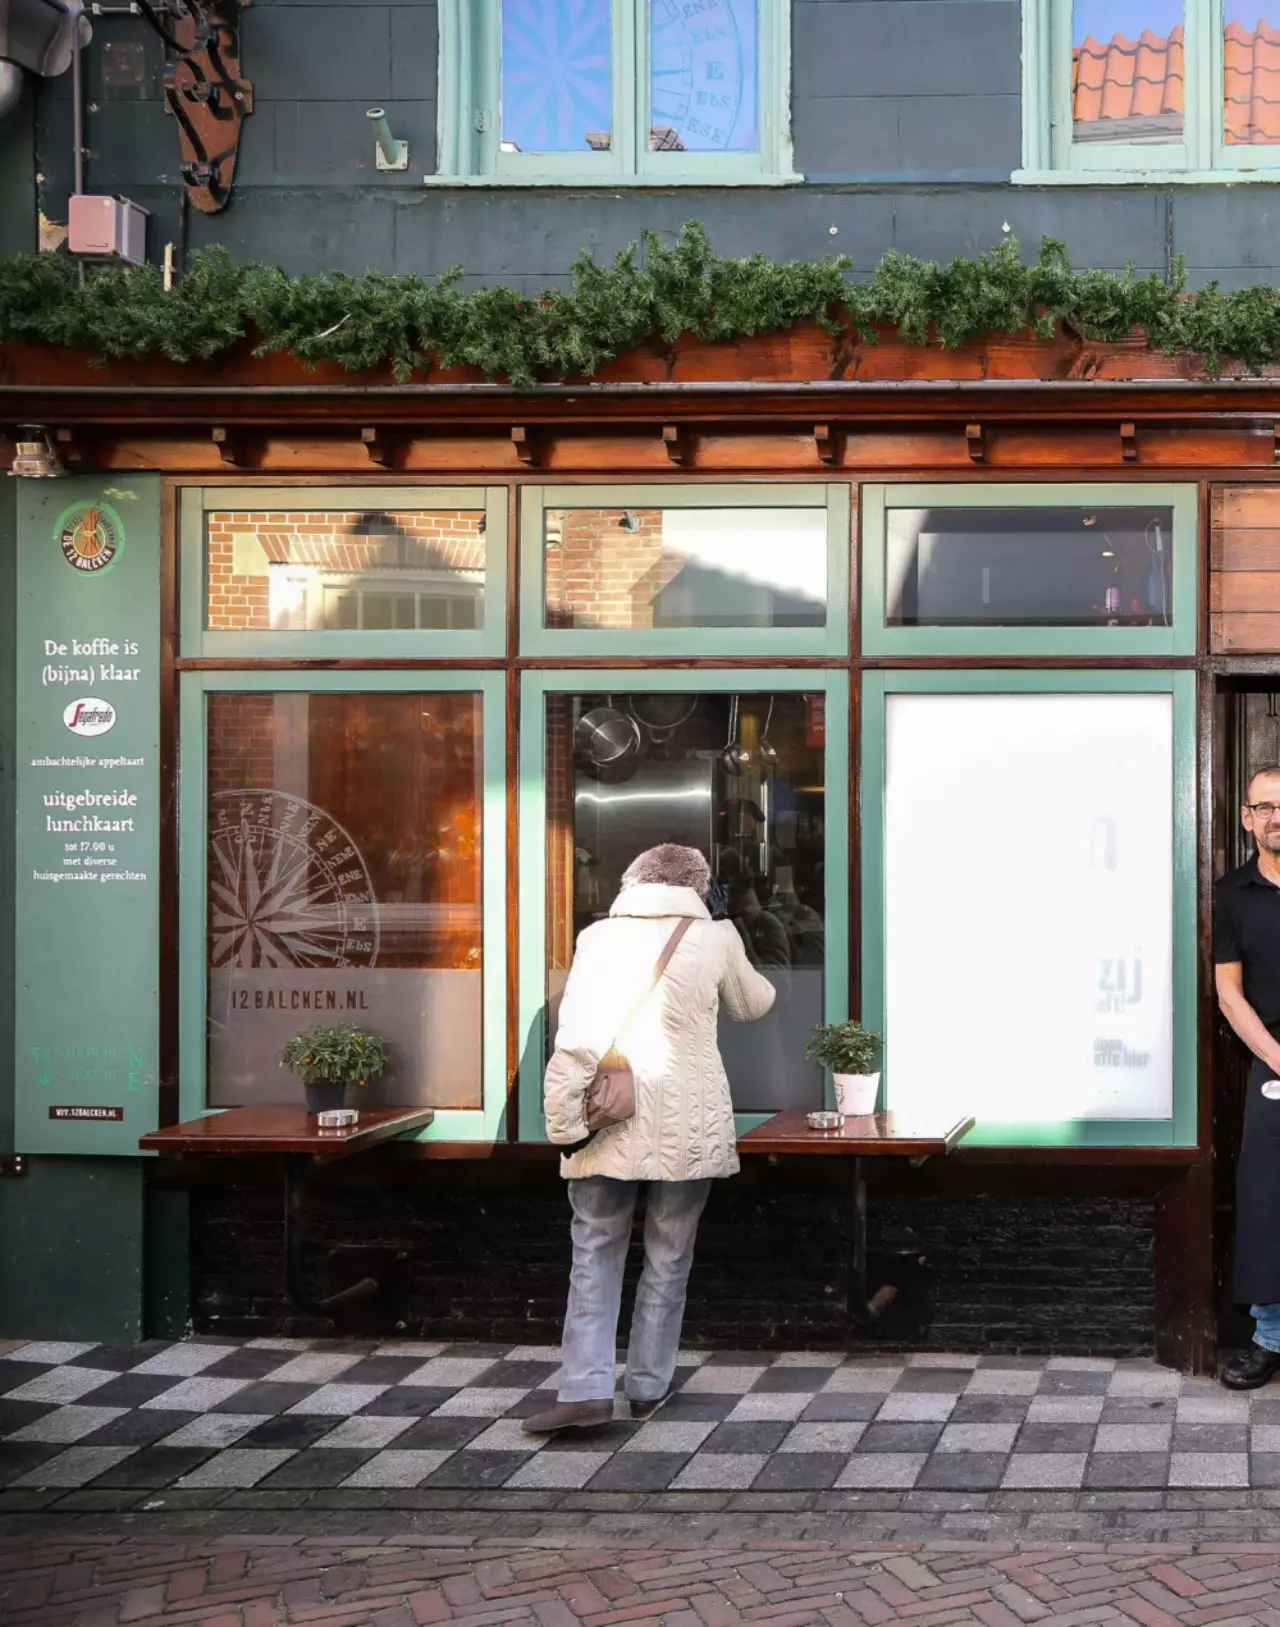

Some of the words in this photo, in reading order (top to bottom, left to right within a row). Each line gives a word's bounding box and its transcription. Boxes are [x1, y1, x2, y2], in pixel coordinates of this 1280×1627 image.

[706, 61, 724, 80] E
[44, 640, 67, 656] De
[72, 639, 119, 656] koffie
[124, 639, 139, 656] is
[42, 664, 95, 686] (bijna)
[99, 665, 140, 681] klaar
[31, 757, 96, 768] ambachtelijke
[98, 757, 144, 768] appeltaart
[43, 790, 137, 811] uitgebreide
[46, 815, 135, 832] lunchkaart
[64, 843, 77, 851] tot
[63, 857, 81, 866] met
[83, 857, 117, 866] diverse
[33, 871, 98, 882] huisgemaakte
[100, 871, 147, 882] gerechten
[232, 990, 369, 1010] 12BALCKEN.NL
